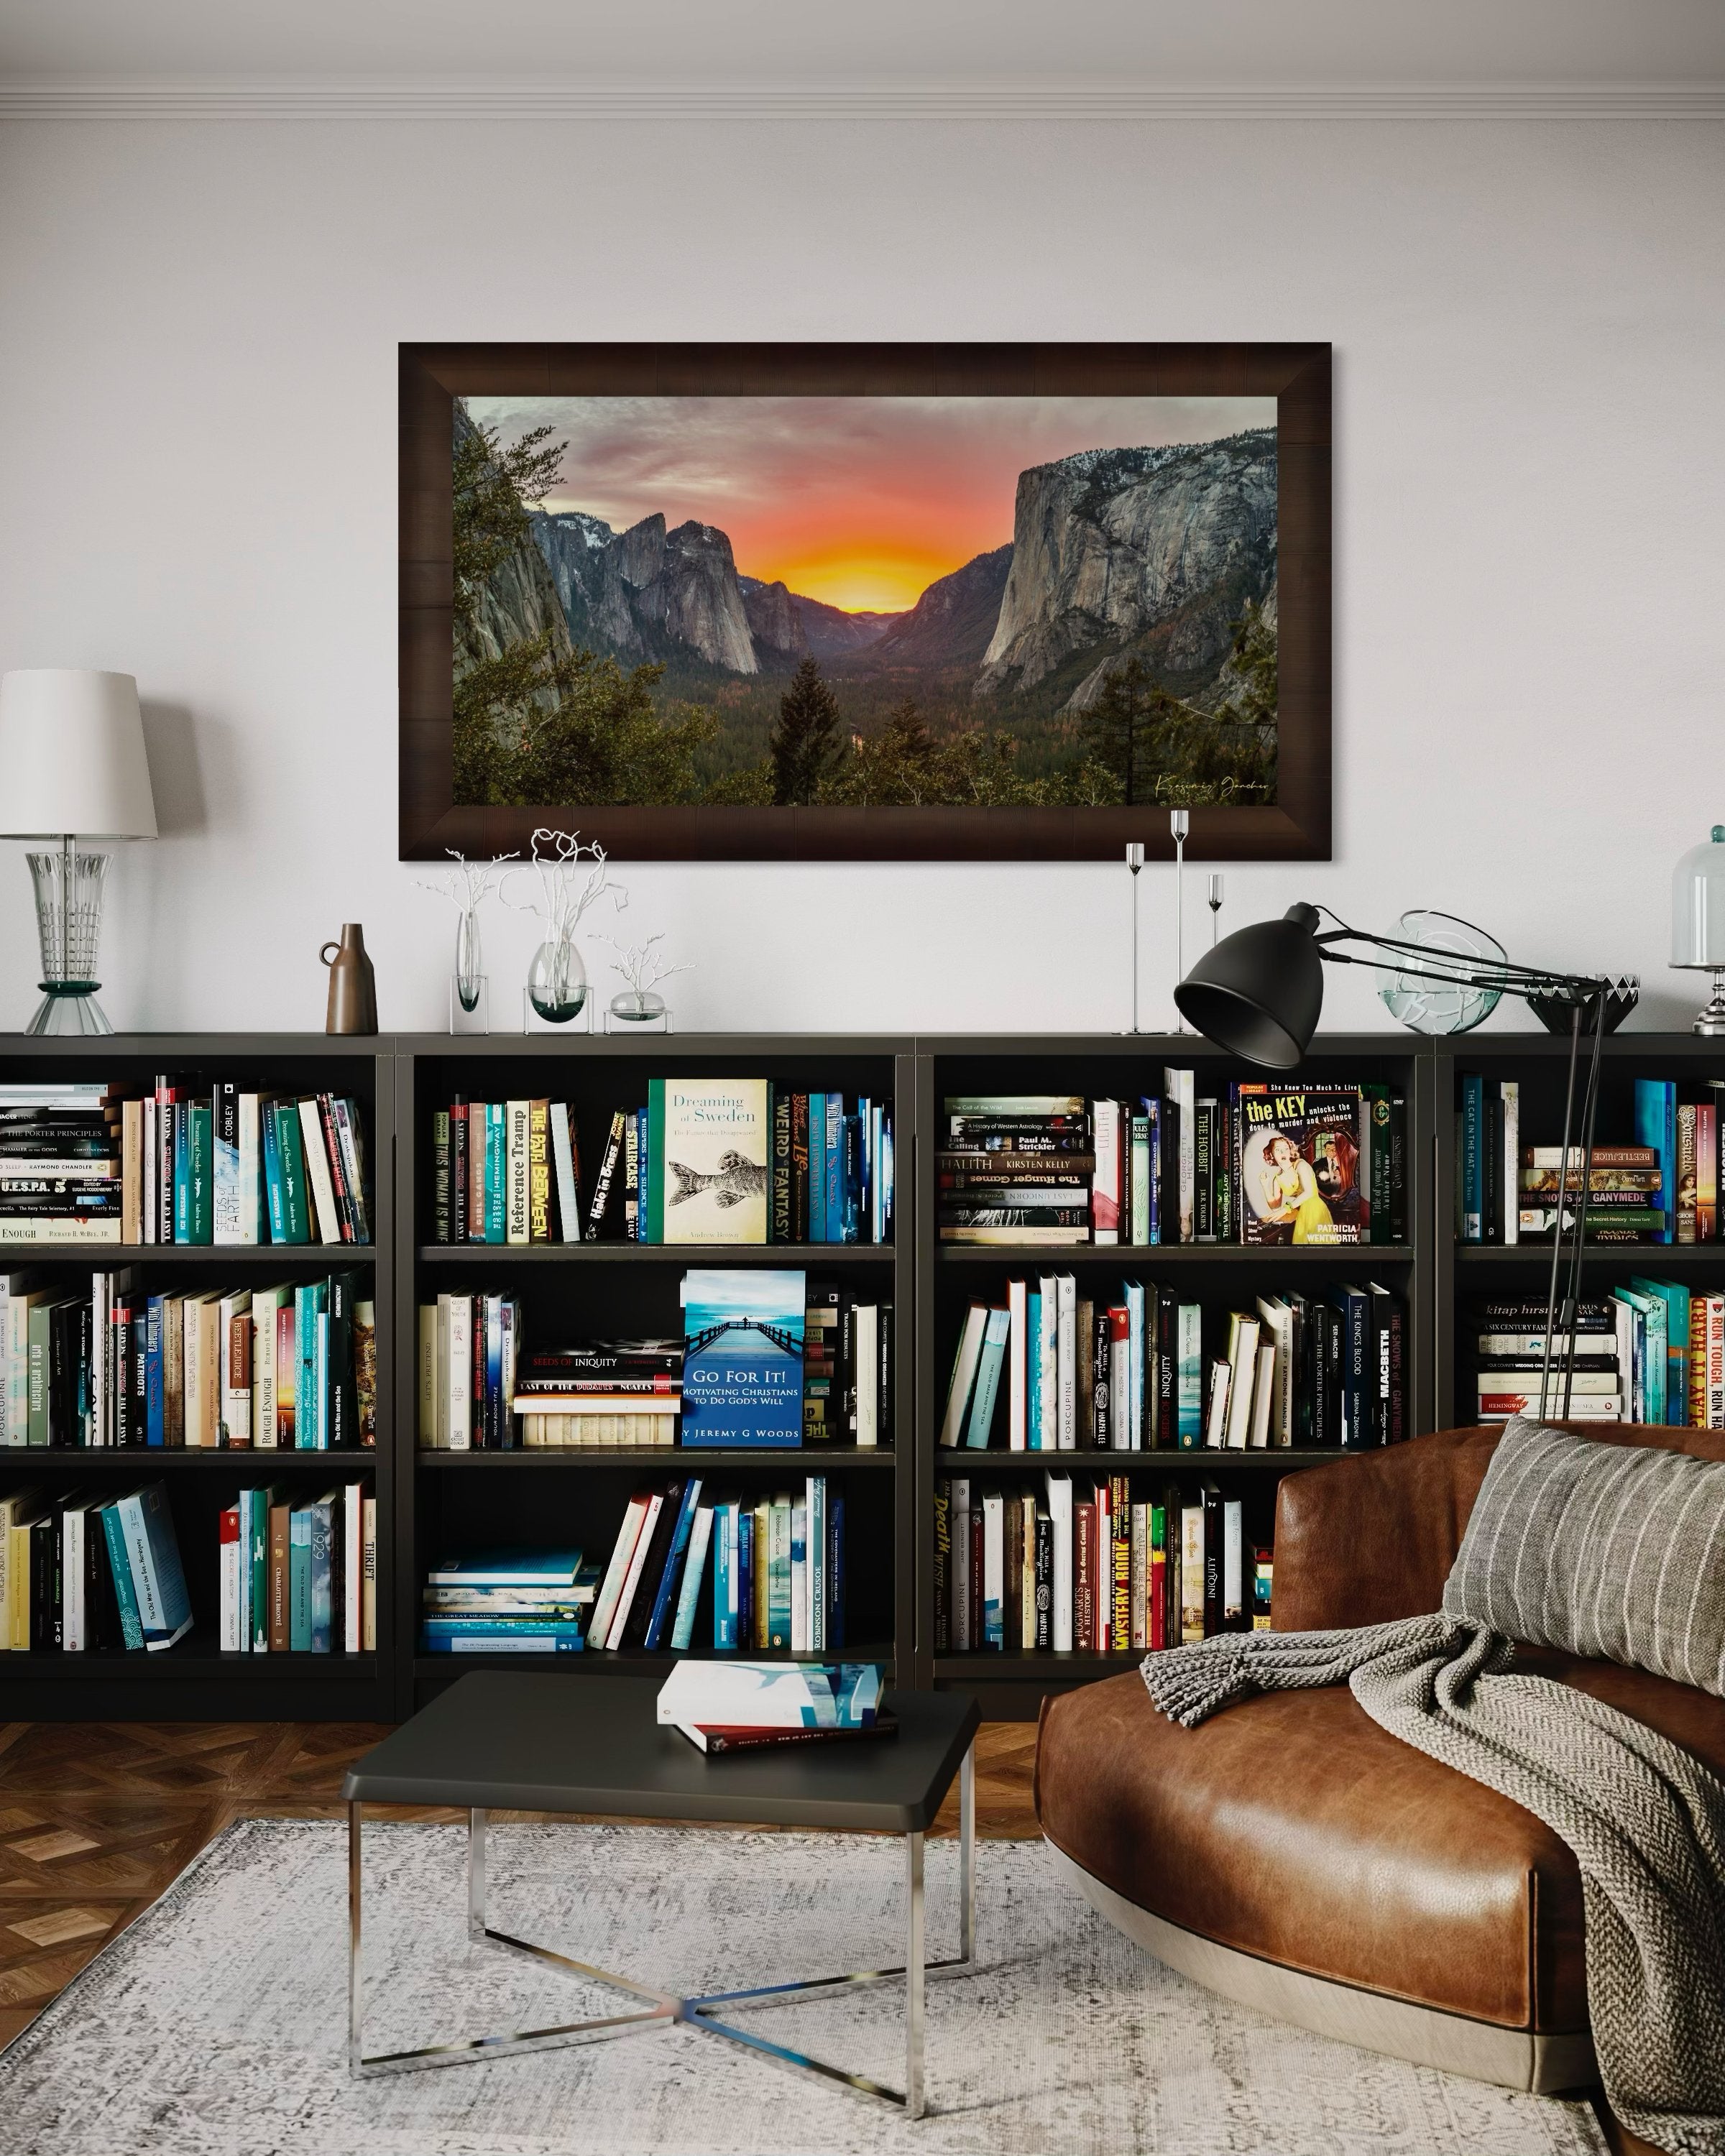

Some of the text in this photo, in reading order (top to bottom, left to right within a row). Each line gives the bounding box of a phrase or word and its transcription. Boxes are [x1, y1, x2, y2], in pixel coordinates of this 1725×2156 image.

[673, 1095, 744, 1110] Dreaming
[694, 1109, 755, 1122] Sweden
[792, 1094, 801, 1143] Shadows
[799, 1094, 808, 1128] Where
[1246, 1101, 1272, 1123] the
[1275, 1095, 1305, 1119] KEY
[1309, 1106, 1335, 1115] unlocks
[1279, 1120, 1303, 1129] murder
[1323, 1114, 1351, 1123] violence
[827, 1104, 840, 1149] Witi Ihimaera
[1199, 1114, 1208, 1174] THE HOBBIT
[1468, 1125, 1475, 1133] IN
[1677, 1107, 1696, 1171] Consuelo
[511, 1110, 526, 1235] Reference Tramp
[530, 1107, 548, 1237] THE PATH BETWEEN
[626, 1130, 638, 1189] STAIRCASE
[776, 1103, 789, 1238] WEIRD FANTASY
[793, 1143, 808, 1170] Lie
[1, 1181, 66, 1192] U.E.S.P.A. 5
[436, 1144, 448, 1242] THIS WOMAN IS MINE
[590, 1145, 618, 1219] Halo in Brass
[970, 1174, 1080, 1184] The Hunger Games
[1372, 1148, 1381, 1215] Title of your cover
[164, 1206, 171, 1216] OF
[32, 1344, 42, 1358] arts
[148, 1307, 160, 1353] Witi Ihimaera
[576, 1358, 617, 1368] INIQUITY
[1162, 1355, 1172, 1398] INIQUITY
[1380, 1330, 1389, 1399] MACBETH
[1690, 1297, 1707, 1429] PLAY IT HARD
[1710, 1317, 1723, 1411] RUN TOUGH, RUN
[32, 1369, 42, 1411] architecture
[120, 1414, 126, 1423] OF
[313, 1531, 325, 1560] 1929
[364, 1542, 374, 1581] THRIFT
[934, 1494, 950, 1588] Death WISH
[1208, 1557, 1218, 1599] INIQUITY
[1075, 1587, 1084, 1637] HOGWARTS
